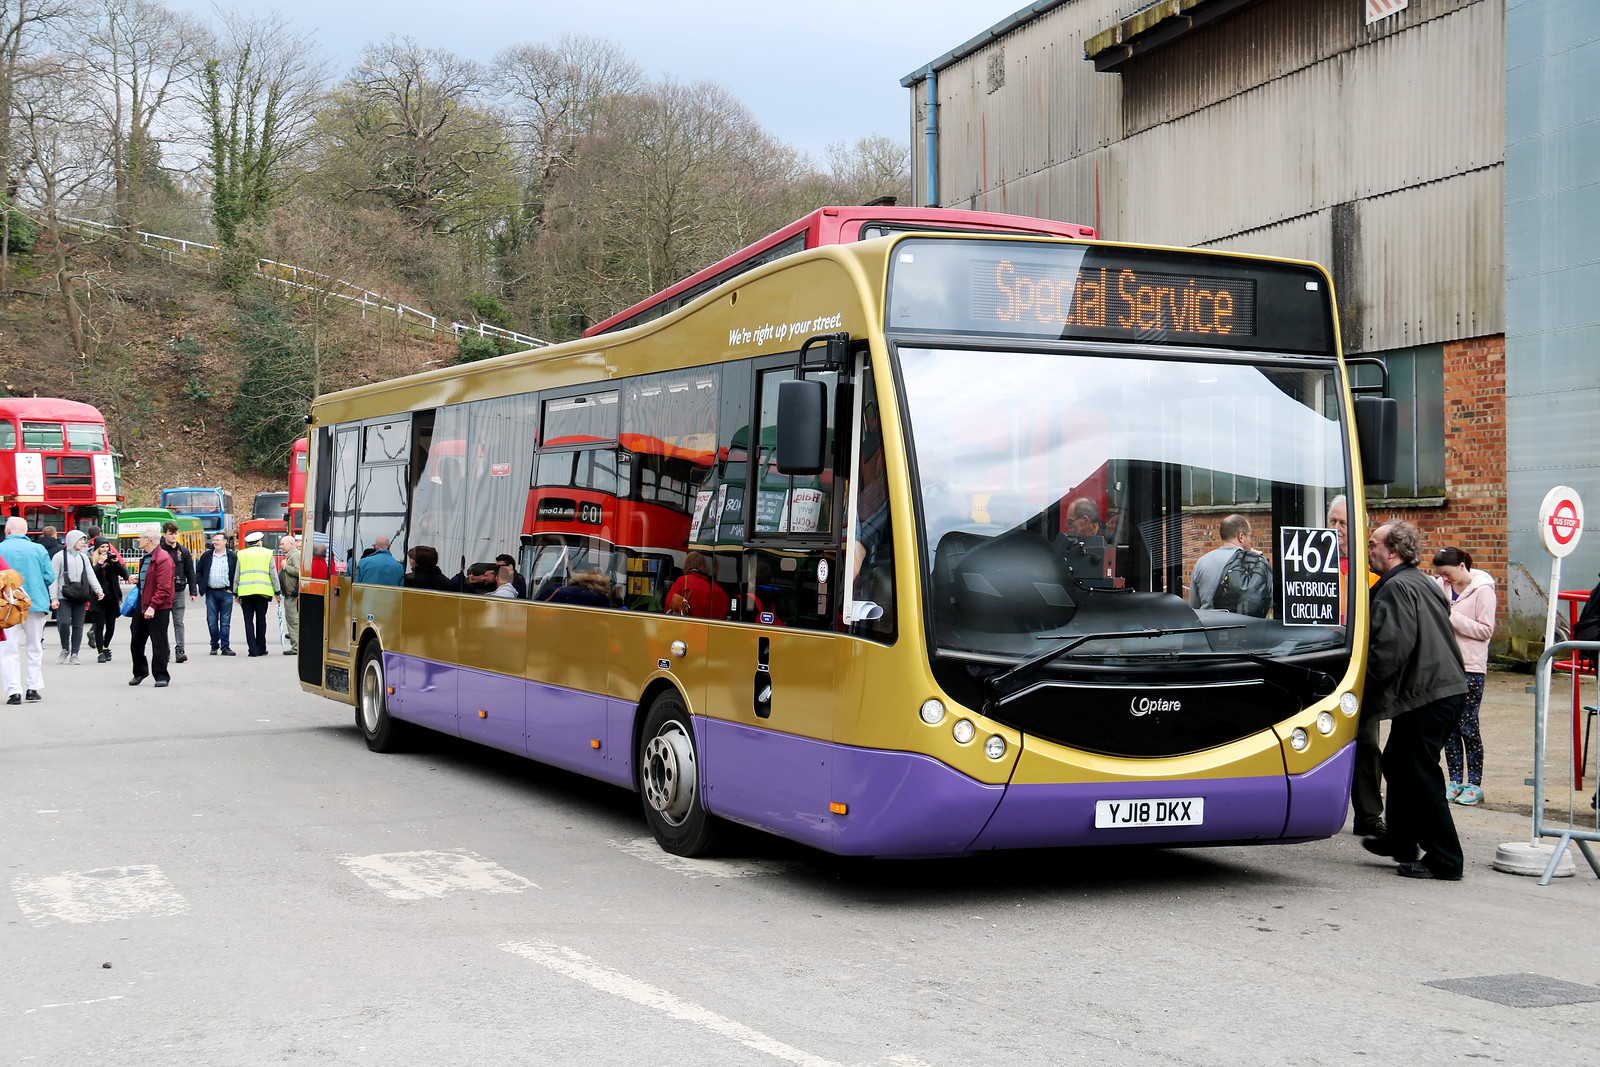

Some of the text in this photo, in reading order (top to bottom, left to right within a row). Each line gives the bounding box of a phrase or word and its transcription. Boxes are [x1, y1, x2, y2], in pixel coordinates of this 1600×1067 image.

[996, 260, 1233, 334] Special Service
[729, 312, 842, 346] We're right up your street.
[1284, 530, 1339, 573] 462
[1286, 581, 1338, 597] WEYBRIDGE
[1291, 603, 1334, 619] CIRCULAR
[1137, 698, 1182, 715] Optare
[1109, 801, 1192, 823] YJ18 DKX
